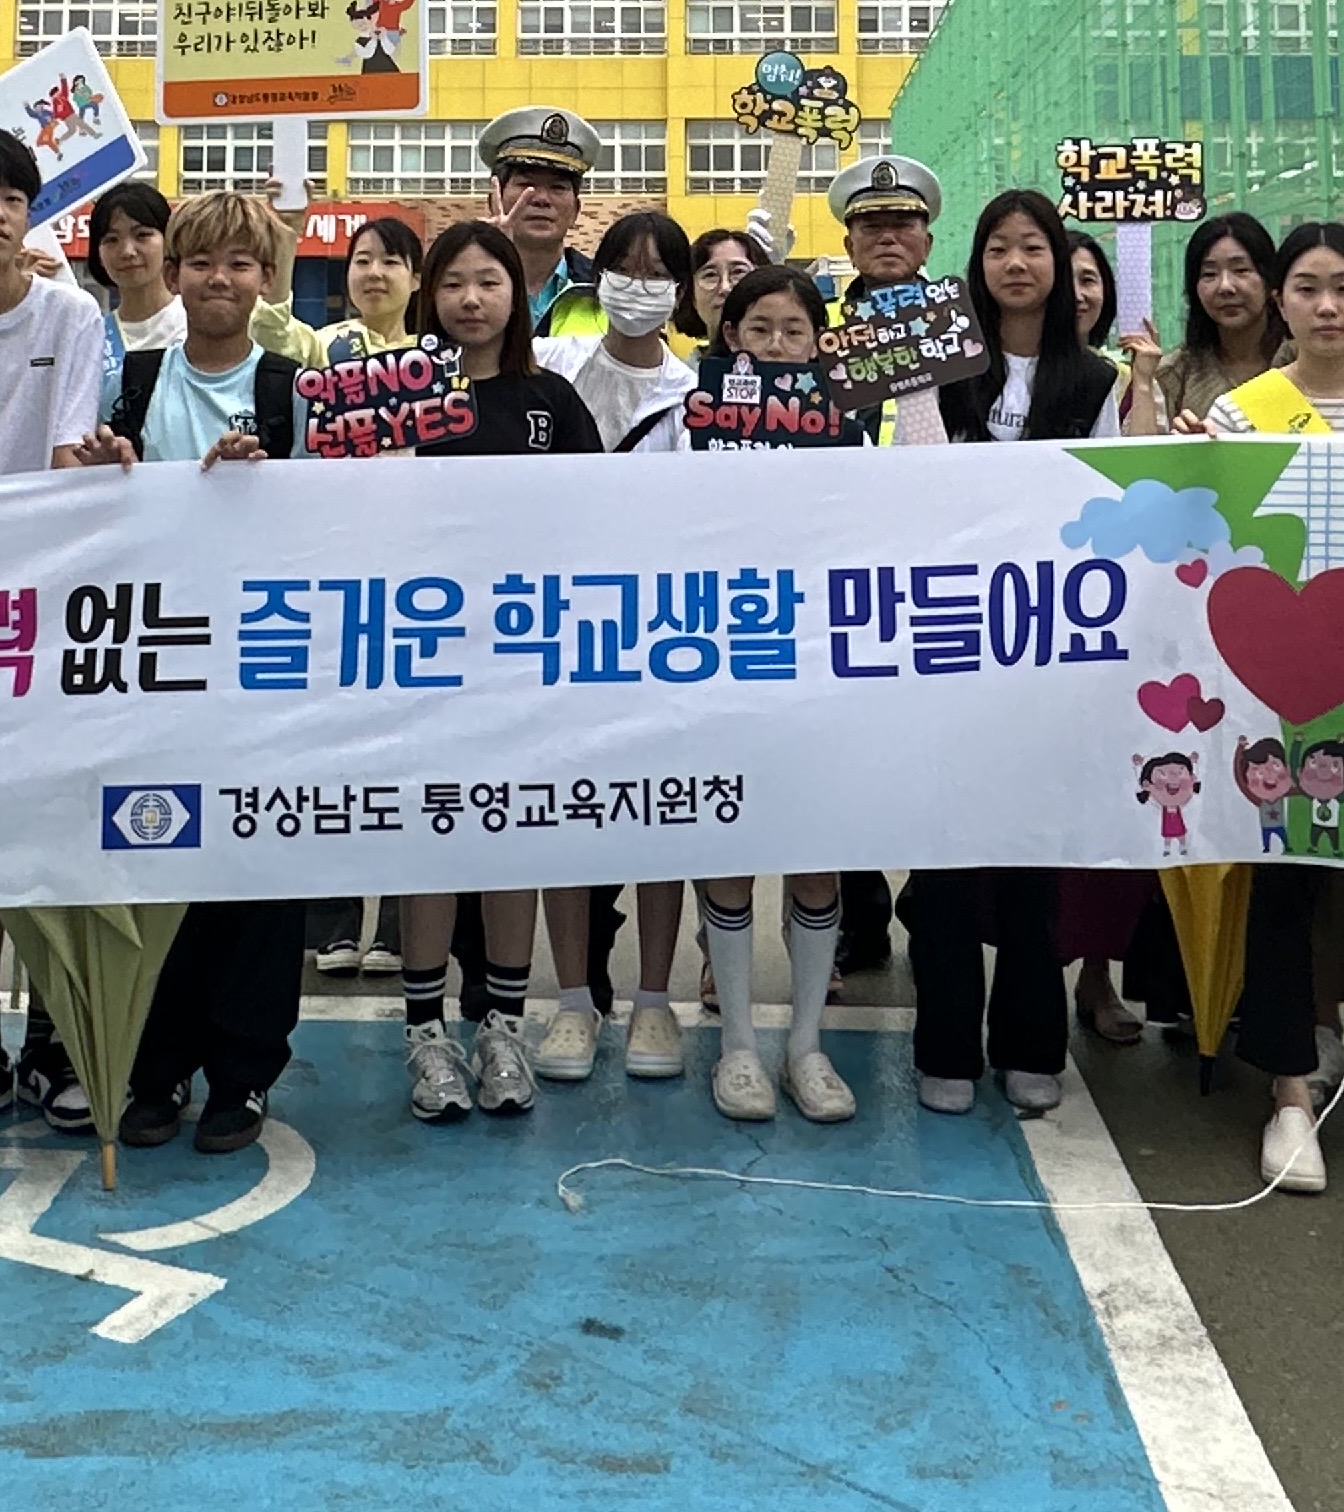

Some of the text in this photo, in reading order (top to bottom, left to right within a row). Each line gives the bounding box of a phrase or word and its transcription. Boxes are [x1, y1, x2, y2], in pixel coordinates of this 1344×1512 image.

[172, 30, 237, 57] 우리가
[732, 88, 860, 150] 학교폭력
[1056, 137, 1203, 185] 학교폭력
[847, 345, 921, 383] 행복한
[918, 332, 962, 362] 학교
[686, 390, 762, 437] Say
[59, 581, 213, 696] 없는
[237, 574, 466, 692] 즐거운
[491, 567, 805, 687] 학교생활
[827, 557, 1129, 678] 만들어요
[218, 774, 746, 839] 경상남도 통영교육지원청
